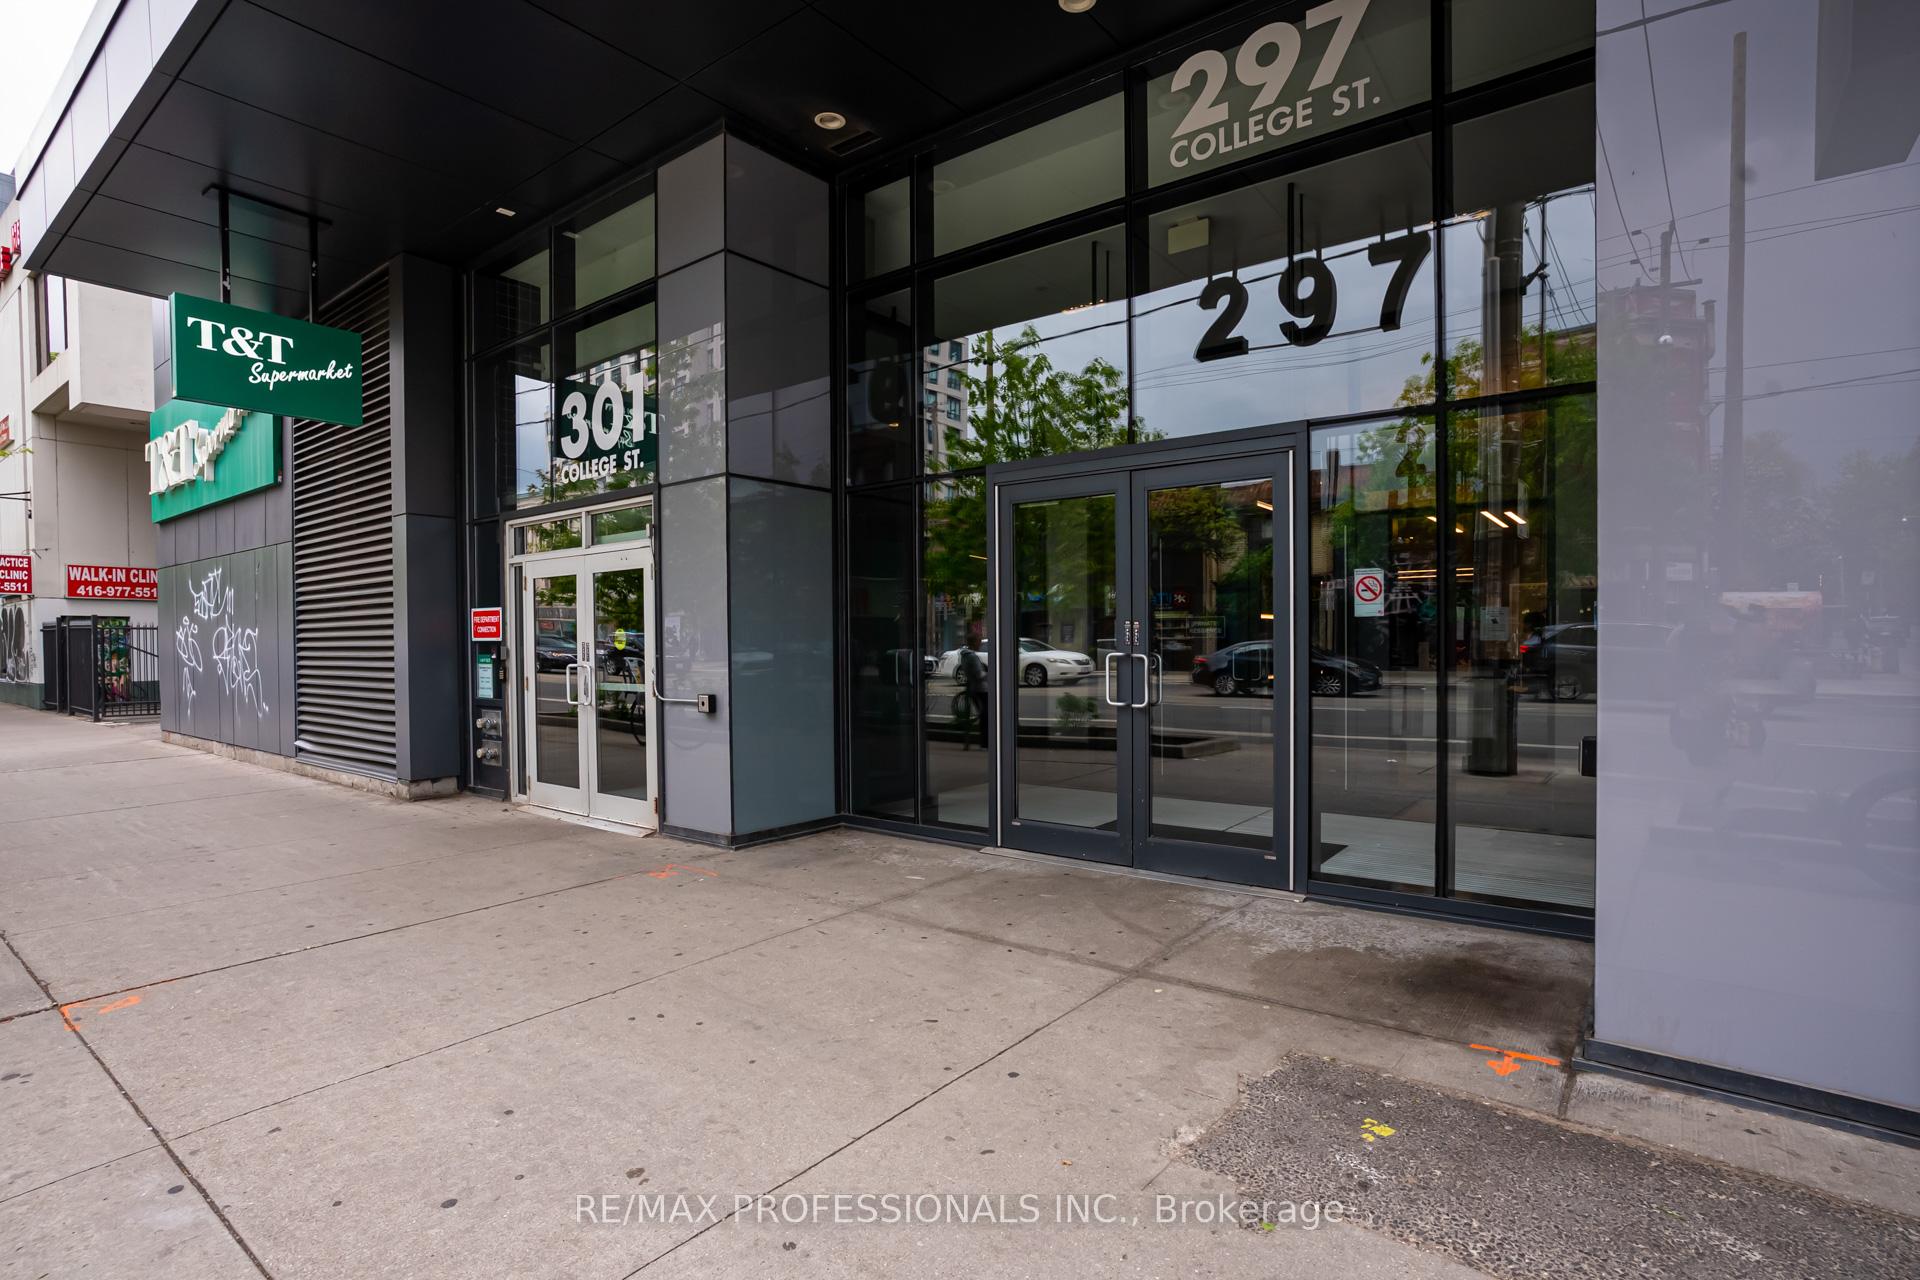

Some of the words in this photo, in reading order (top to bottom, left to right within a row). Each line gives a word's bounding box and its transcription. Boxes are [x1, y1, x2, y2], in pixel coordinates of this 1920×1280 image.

[1170, 0, 1371, 139] 297
[1169, 96, 1313, 168] COLLEGE
[1331, 77, 1381, 117] ST.
[186, 316, 294, 365] T&T
[248, 359, 353, 391] Supermarket
[560, 371, 645, 459] 301
[561, 454, 618, 485] COLLEGE
[623, 448, 645, 472] ST.
[0, 569, 28, 580] CLINIC
[0, 581, 28, 592] -5511
[68, 566, 126, 583] WALK-IN
[129, 569, 158, 584] CLIN
[76, 585, 158, 598] 416-977-551
